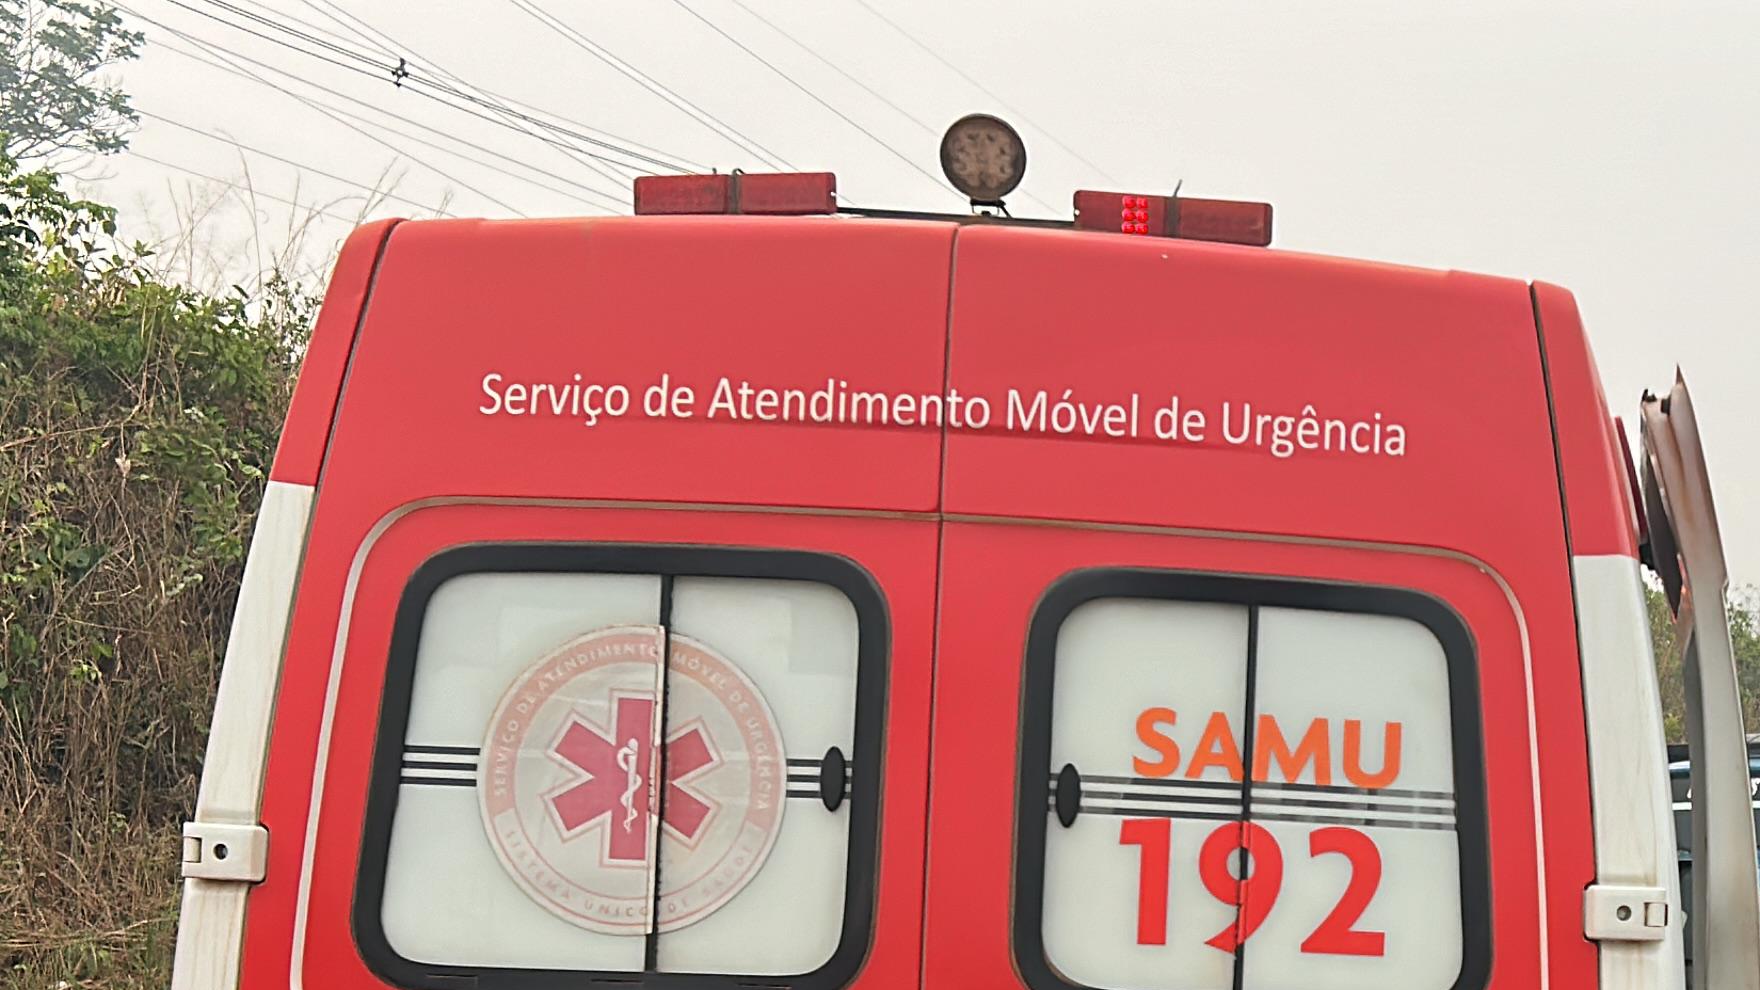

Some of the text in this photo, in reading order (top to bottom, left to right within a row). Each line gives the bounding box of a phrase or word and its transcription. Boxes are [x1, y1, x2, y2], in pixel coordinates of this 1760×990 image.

[478, 372, 1407, 459] Serviço de Atendimento Móvel de Urgência
[1131, 707, 1402, 788] SAMU
[1119, 816, 1385, 957] 192
